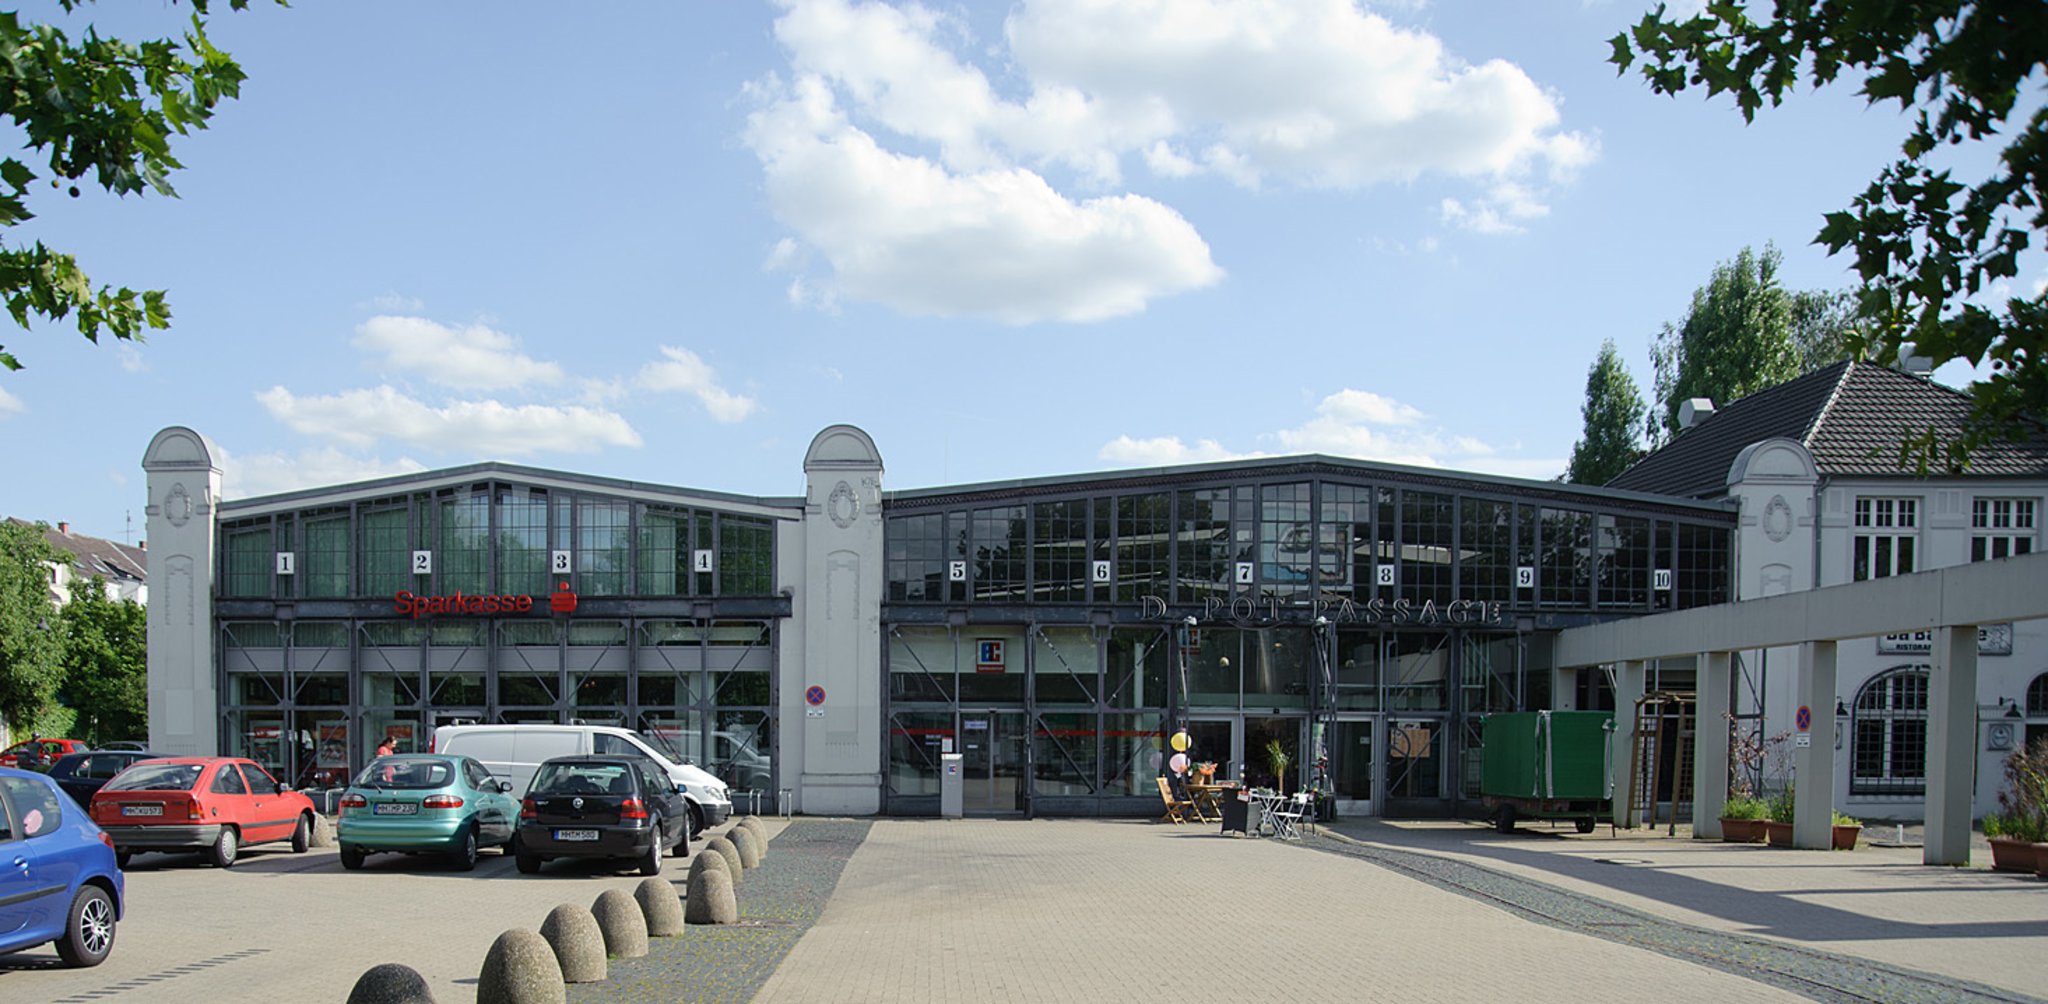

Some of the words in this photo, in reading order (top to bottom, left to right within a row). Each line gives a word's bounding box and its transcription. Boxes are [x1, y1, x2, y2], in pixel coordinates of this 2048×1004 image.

[282, 556, 289, 571] 1
[417, 555, 427, 570] 2
[556, 555, 567, 570] 3
[698, 554, 709, 570] 4
[952, 564, 964, 579] 5
[1096, 565, 1108, 579] 6
[1239, 565, 1251, 580] 7
[1381, 567, 1392, 582] 8
[1520, 570, 1531, 585] 9
[1656, 571, 1669, 587] 10
[394, 590, 533, 618] Sparkasse
[1313, 598, 1502, 625] PASSAGE
